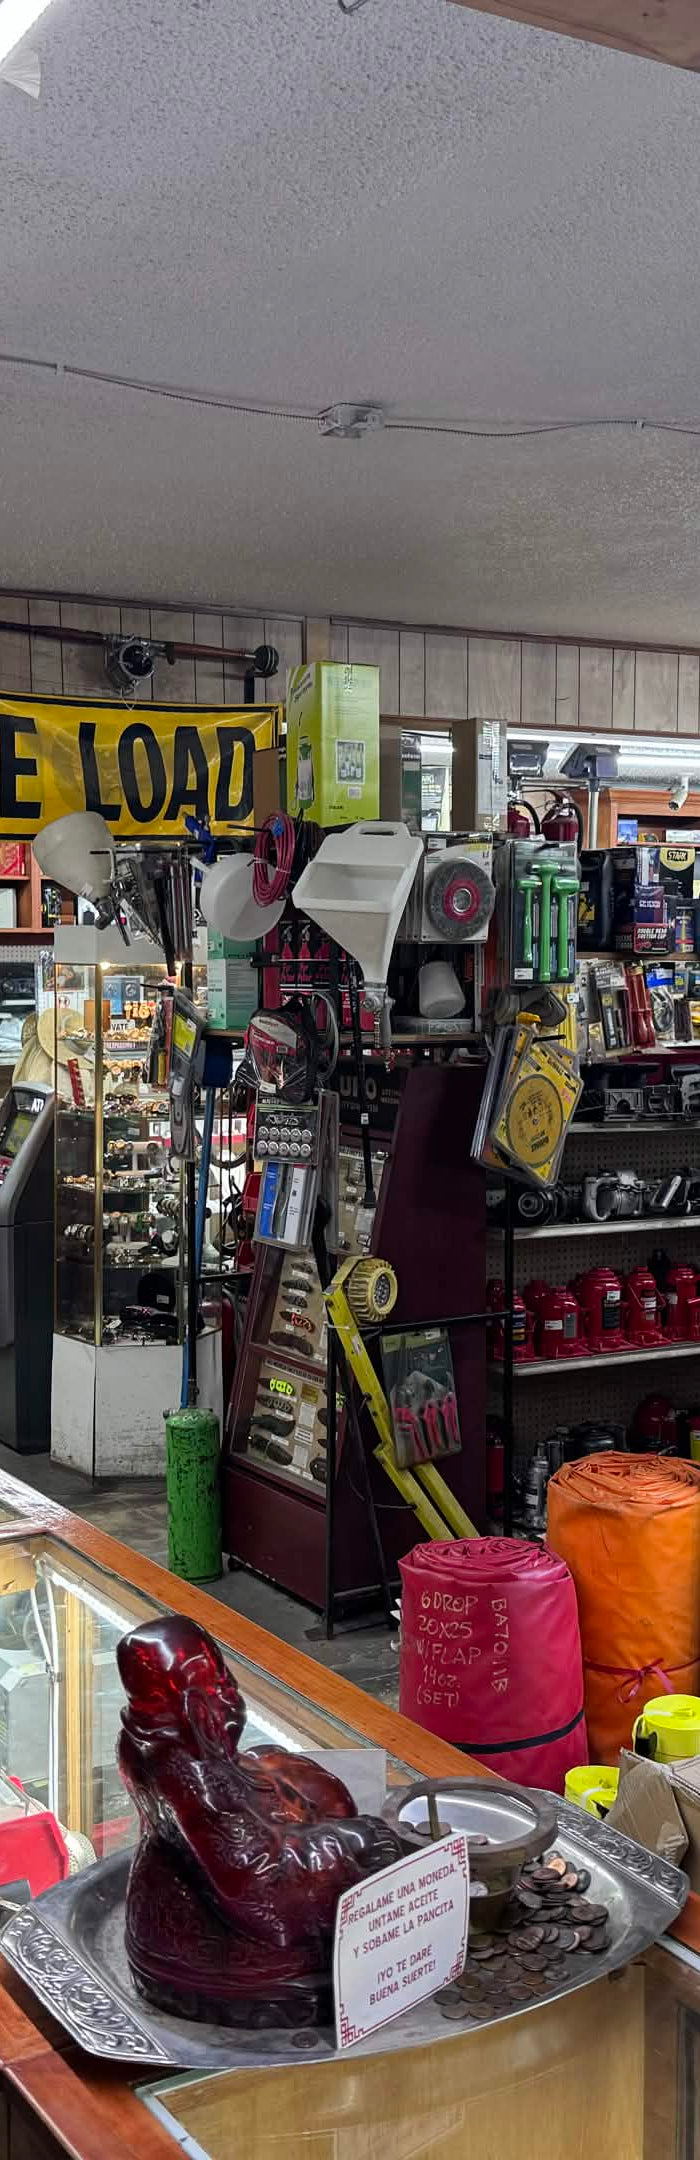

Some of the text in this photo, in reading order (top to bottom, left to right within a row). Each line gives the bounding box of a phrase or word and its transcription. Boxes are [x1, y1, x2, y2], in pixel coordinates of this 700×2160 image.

[79, 722, 256, 823] LOAD
[348, 1890, 395, 1925] REGALAME
[397, 1881, 416, 1899] UNA
[368, 1888, 439, 1932] UNTAME ACEITE
[353, 1899, 454, 1959] Y SOBAME LA PANCITA
[369, 1959, 436, 2006] BUENA SUERTE!
[396, 1959, 407, 1973] TE
